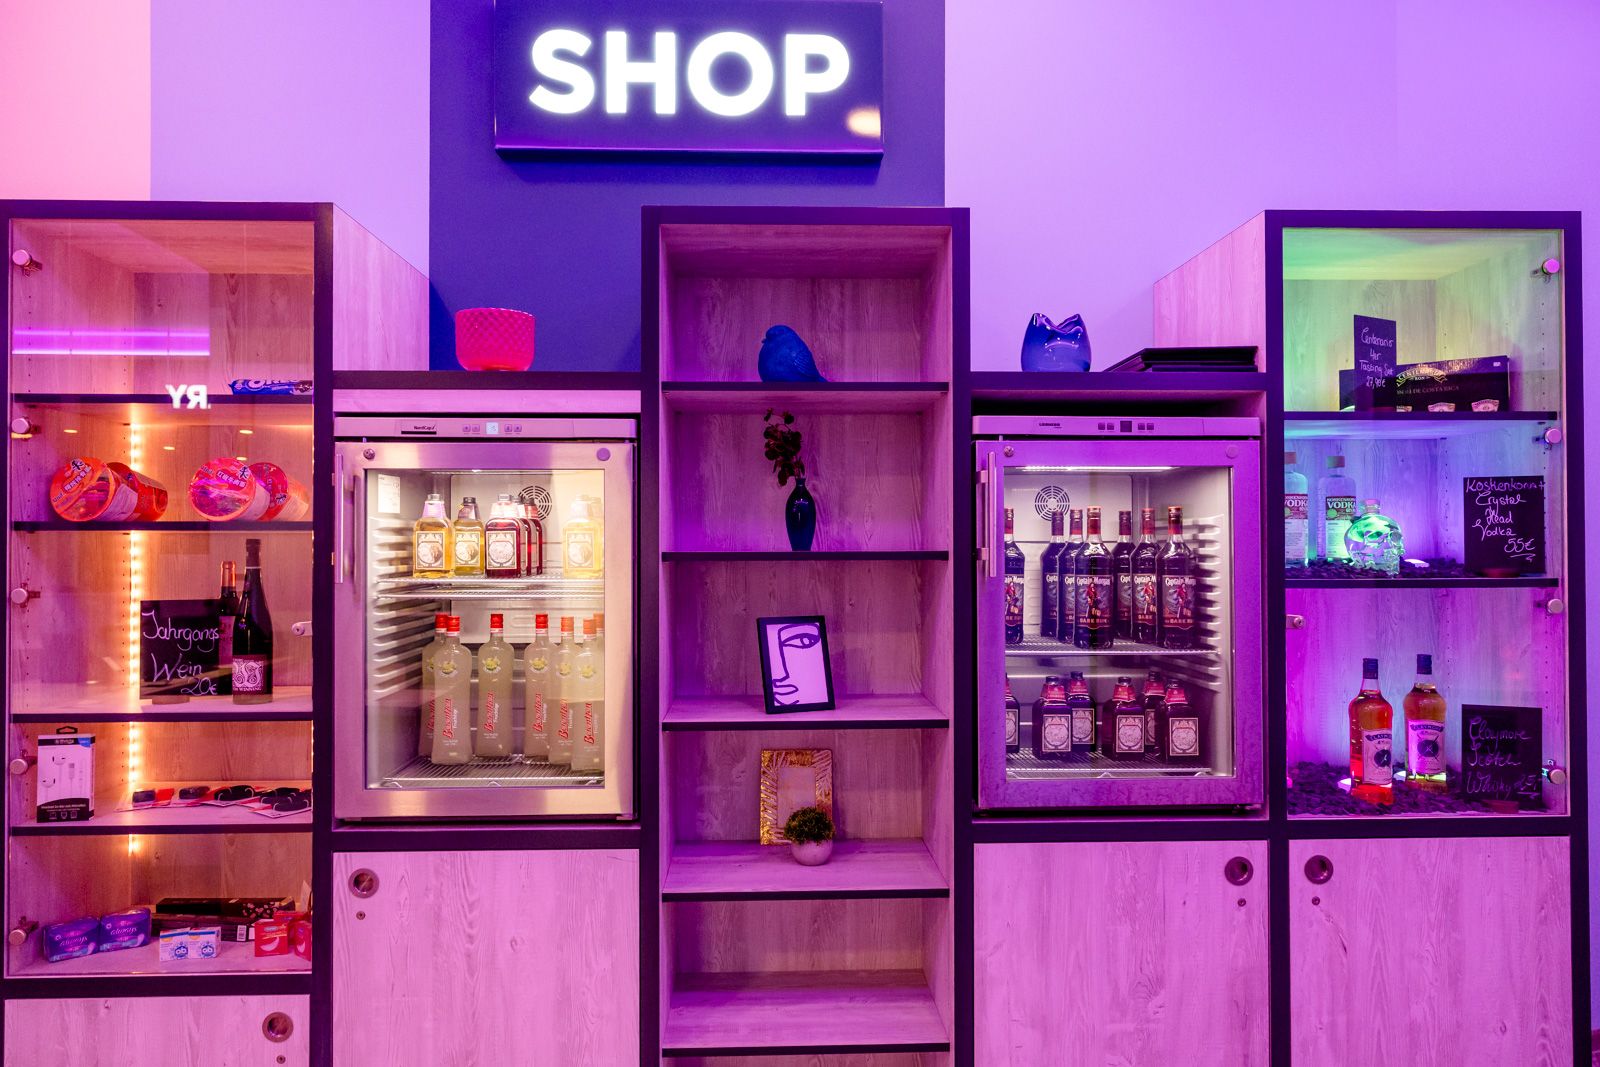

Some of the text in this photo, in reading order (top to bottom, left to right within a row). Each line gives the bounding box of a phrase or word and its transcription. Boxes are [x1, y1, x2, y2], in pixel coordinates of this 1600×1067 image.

[529, 28, 850, 117] SHOP
[1476, 491, 1527, 515] Crystal
[1504, 537, 1535, 553] 55€
[142, 609, 219, 653] Jahrgangs
[151, 653, 203, 683] Wein
[181, 676, 218, 696] 20€
